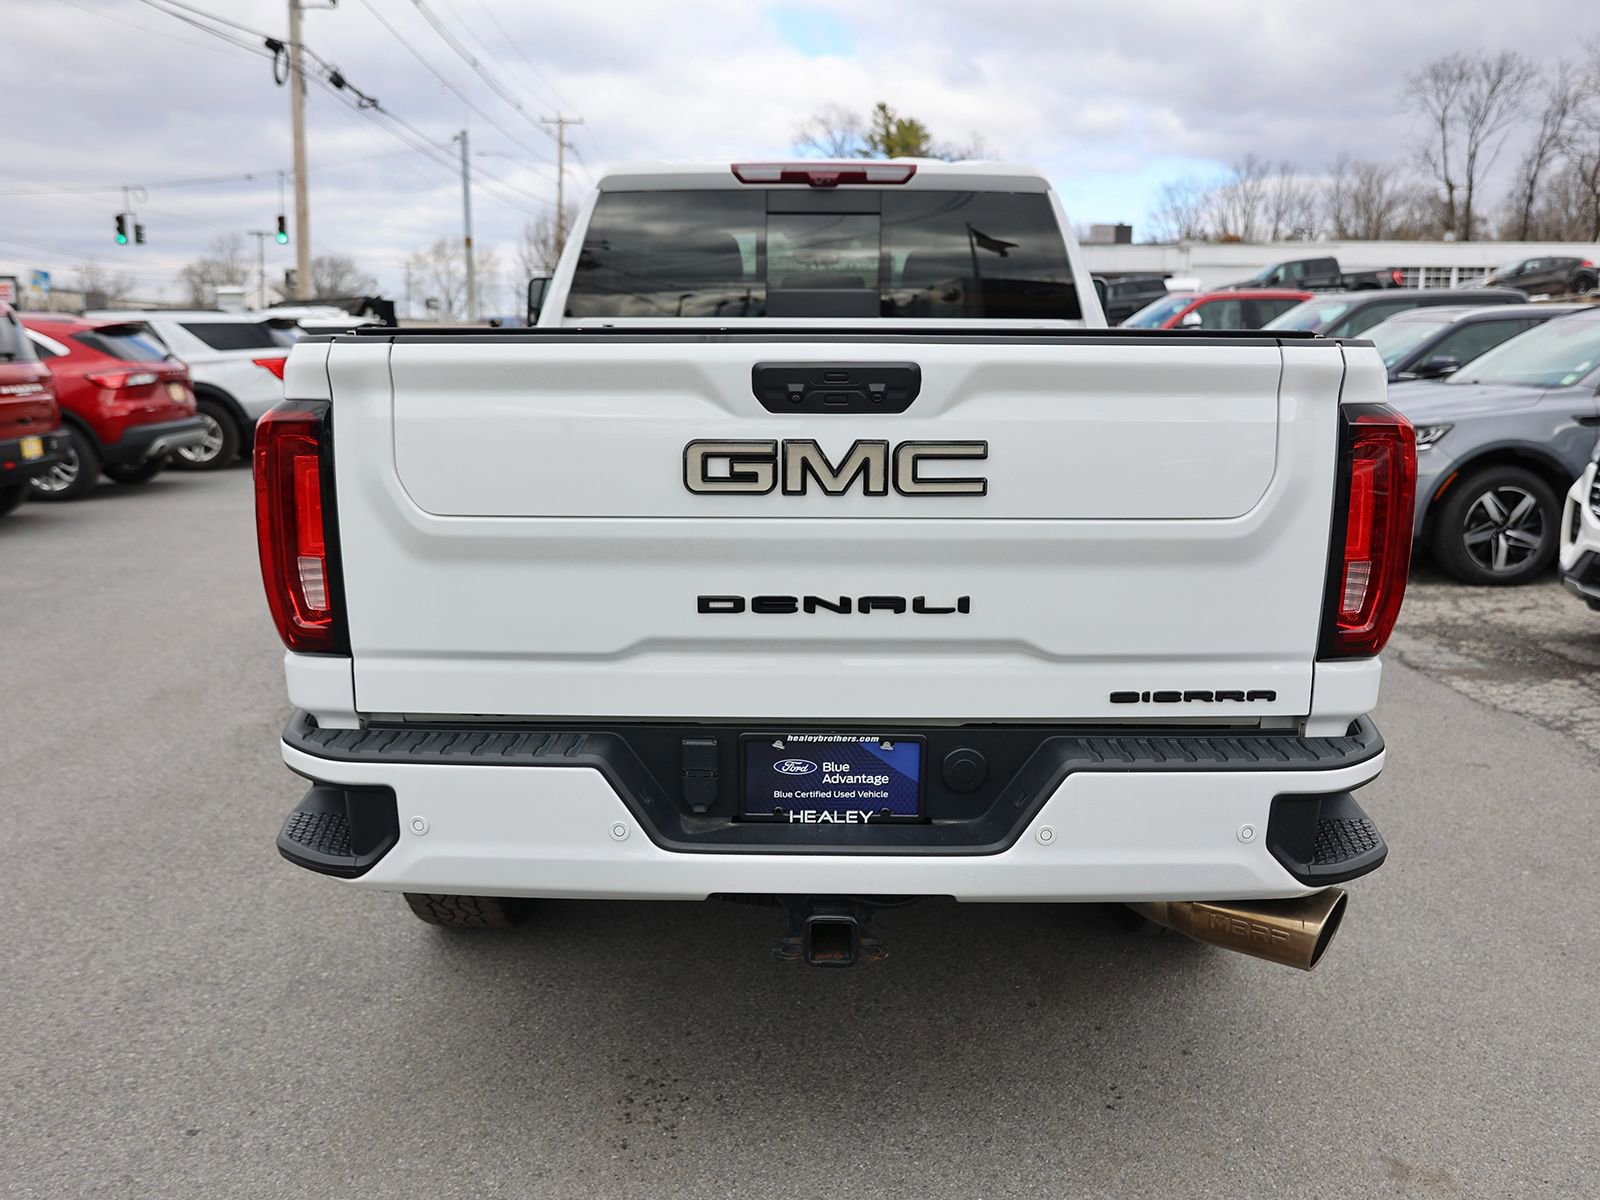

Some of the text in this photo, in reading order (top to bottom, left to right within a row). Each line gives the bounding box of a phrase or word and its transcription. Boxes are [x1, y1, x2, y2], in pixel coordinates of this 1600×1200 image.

[683, 438, 988, 497] GMC
[697, 595, 970, 614] DENALI
[1109, 690, 1277, 703] SIERRA
[787, 734, 880, 743] healeybrothers.com
[781, 761, 809, 773] Ford
[822, 762, 850, 773] Blue
[822, 773, 889, 786] Advantage
[773, 790, 889, 798] Blue Certified Used Vehicle
[789, 810, 874, 824] HEALEY
